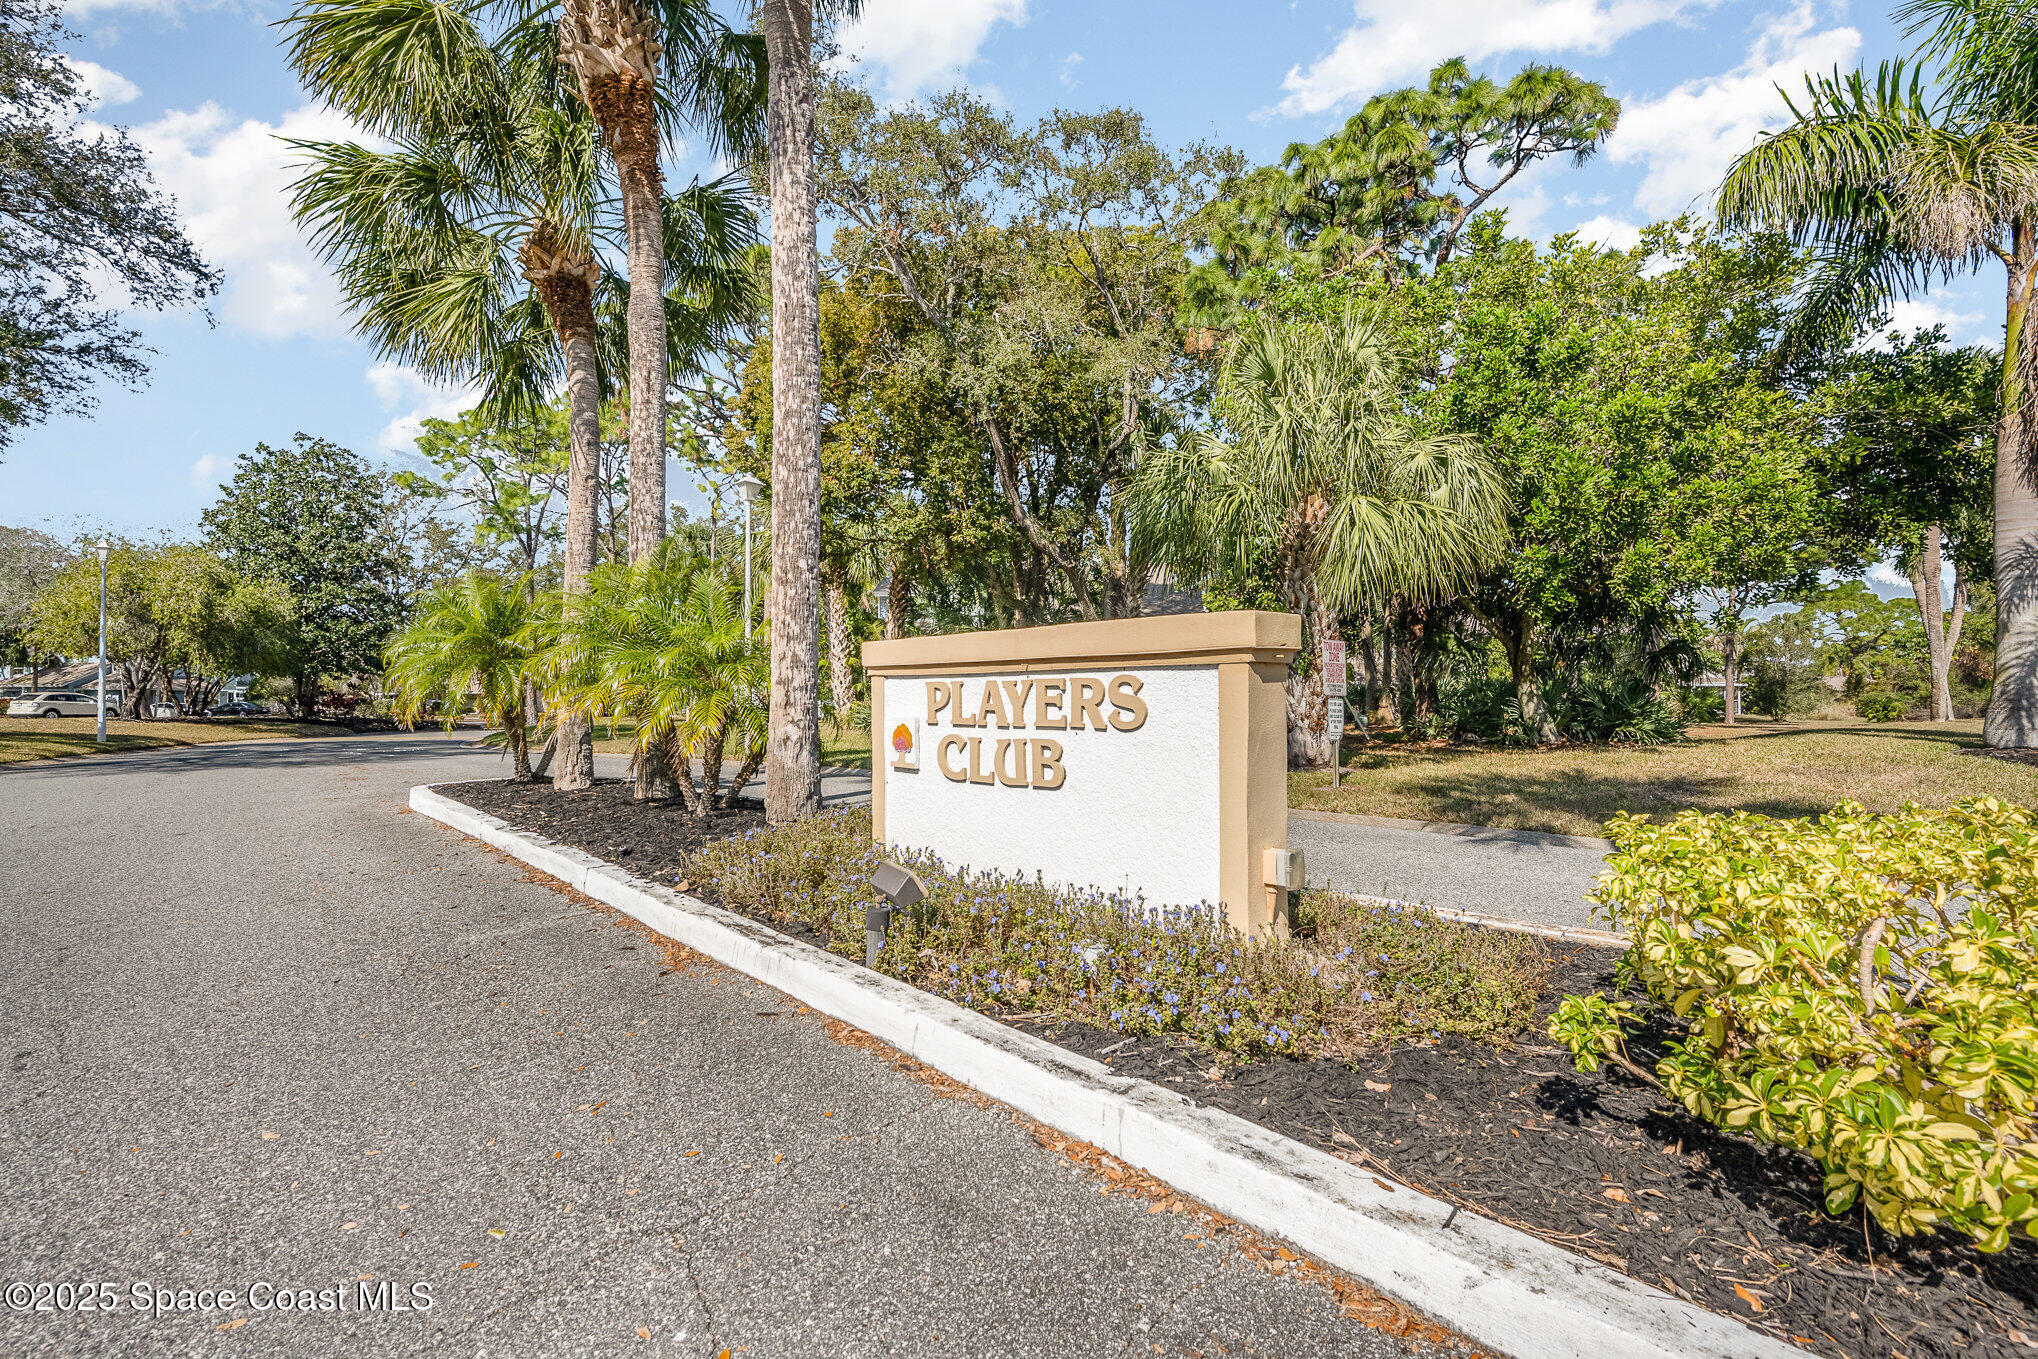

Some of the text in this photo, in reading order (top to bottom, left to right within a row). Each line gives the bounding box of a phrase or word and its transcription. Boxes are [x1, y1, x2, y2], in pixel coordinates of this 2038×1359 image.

[1323, 640, 1332, 651] TOW
[1329, 651, 1340, 662] ZONE
[925, 674, 1149, 732] PLAYERS
[936, 733, 1067, 790] CLUB
